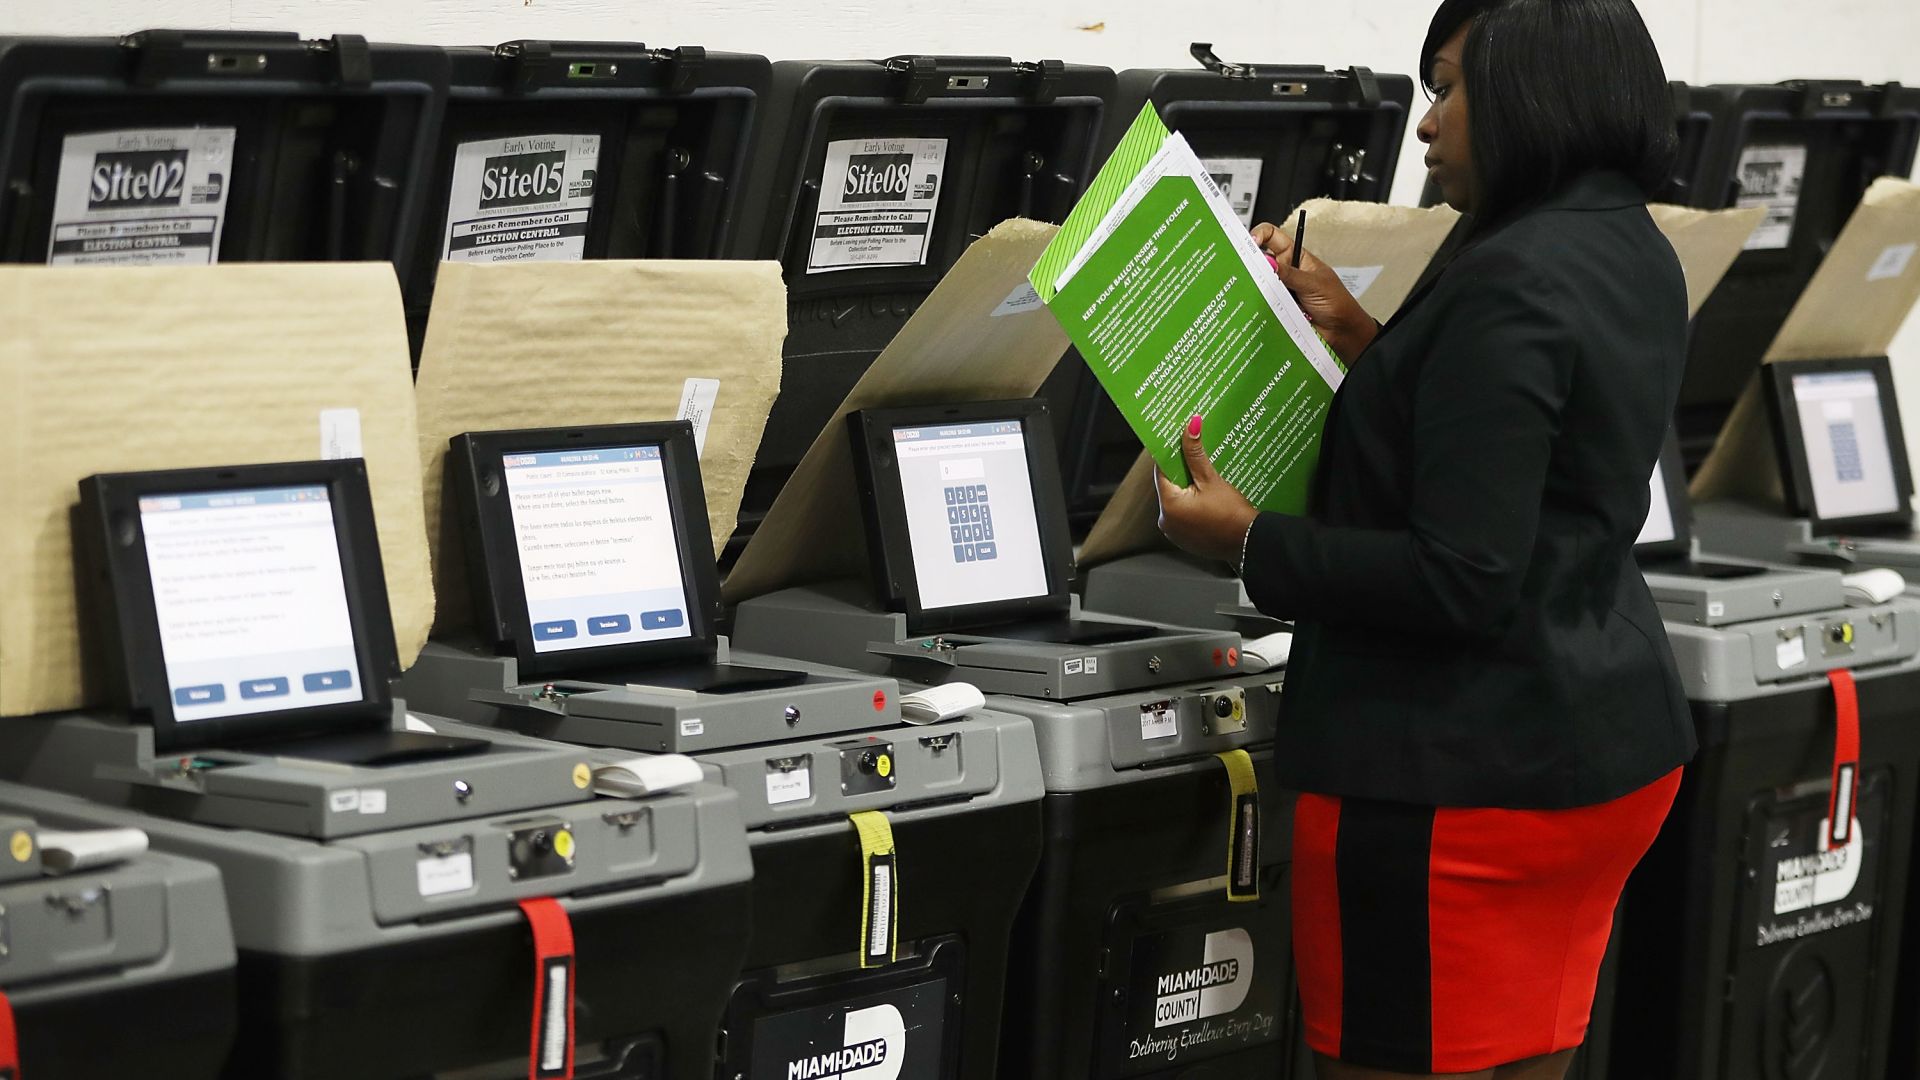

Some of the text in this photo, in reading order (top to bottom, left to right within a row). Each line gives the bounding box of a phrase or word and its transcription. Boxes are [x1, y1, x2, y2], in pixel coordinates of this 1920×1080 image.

[504, 139, 556, 154] Early Voting
[864, 142, 905, 153] Early Voting
[91, 160, 185, 202] Site02
[481, 162, 565, 201] Site05
[845, 164, 910, 195] Site08
[471, 219, 495, 232] Please
[498, 218, 543, 228] Remember
[554, 214, 570, 223] Call
[833, 215, 854, 223] Please
[855, 213, 890, 222] Remember
[837, 225, 903, 235] ELECTION CENTRAL
[84, 236, 181, 251] ELECTION CENTRAL
[468, 249, 484, 257] Before
[484, 247, 504, 255] Leaving
[517, 244, 534, 252] Polling
[535, 242, 549, 250] Place
[476, 228, 560, 245] ELECTION CENTRAL
[492, 254, 518, 262] Collection
[1083, 199, 1189, 321] KEEP YOUR BALLOT INSIDE THIS FOLDER
[1124, 246, 1158, 288] AT ALL TIMES
[1135, 277, 1237, 399] MANTENGA SU BOLETA DENTRO DE ESTA
[1154, 300, 1227, 389] FUNDA EN TODO MOMENTO
[1208, 361, 1292, 464] ILTEN VÒT W AN ANDEDAN KATAB
[1232, 406, 1266, 450] SA-A TOUTAN
[1777, 849, 1846, 883] MIAMI-DADE
[1157, 961, 1237, 995] MIAMI-DADE
[1157, 997, 1198, 1022] COUNTY
[1129, 1013, 1273, 1061] Delivering Excellence Every Day
[788, 1040, 884, 1080] MIAMI-DADE
